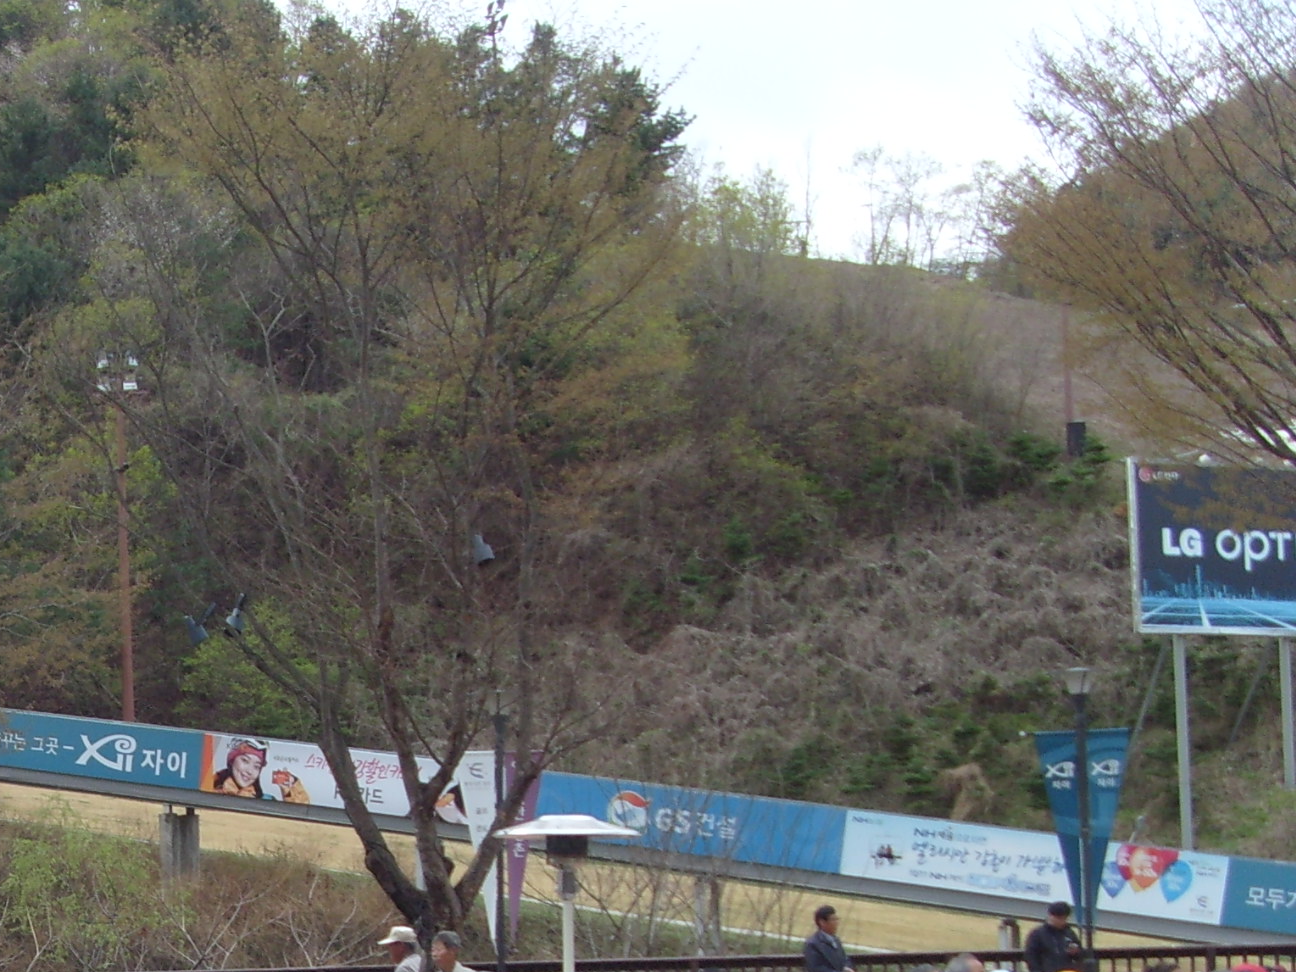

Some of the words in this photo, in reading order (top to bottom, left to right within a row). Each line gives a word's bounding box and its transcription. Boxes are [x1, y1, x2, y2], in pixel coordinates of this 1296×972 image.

[1161, 527, 1203, 557] LG
[31, 736, 59, 756] 그곳
[141, 748, 187, 779] 자이
